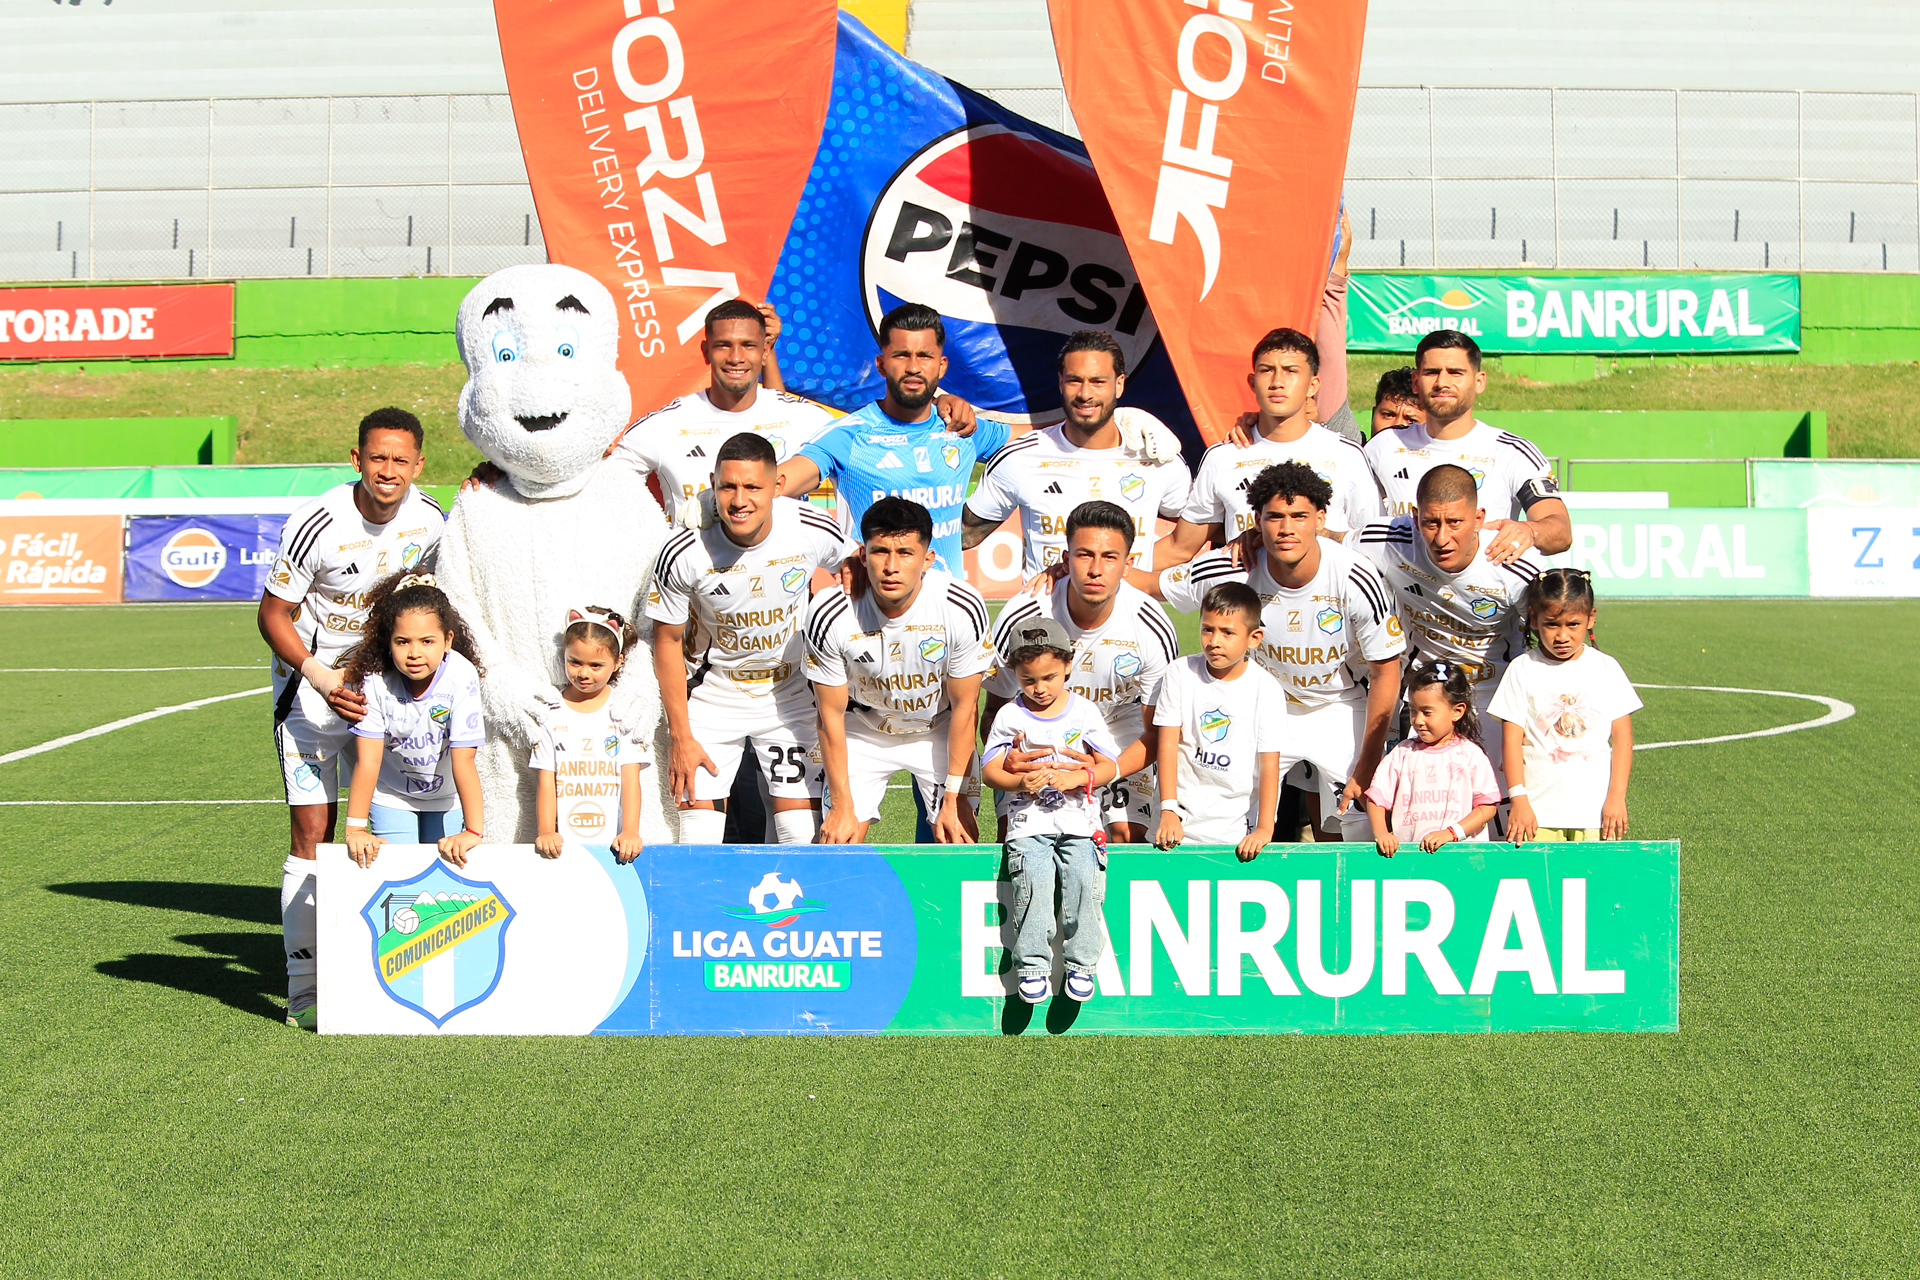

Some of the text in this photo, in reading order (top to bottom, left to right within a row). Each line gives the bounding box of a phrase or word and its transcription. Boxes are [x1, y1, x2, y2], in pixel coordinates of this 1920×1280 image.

[1161, 0, 1254, 178] FO
[573, 67, 665, 358] DELIVERY EXPRESS
[884, 200, 1148, 337] PEPSI
[1506, 288, 1764, 339] BANRURAL
[1388, 316, 1483, 336] BANRURAL
[1046, 460, 1081, 468] FORZA
[401, 526, 428, 538] FORZA
[10, 532, 84, 561] Fácil,
[341, 539, 373, 551] FORZA
[1852, 526, 1884, 568] Z
[167, 550, 222, 567] Gulf
[773, 553, 807, 566] FORZA
[5, 559, 107, 589] Rápida
[711, 564, 747, 574] FORZA
[749, 577, 763, 592] Z
[713, 604, 799, 628] BANRURAL
[1288, 611, 1300, 625] Z
[910, 624, 946, 632] FORZA
[1082, 652, 1093, 665] Z
[1257, 643, 1348, 666] ANRURAL
[1070, 682, 1134, 703] RURAL
[583, 738, 593, 751] Z
[768, 745, 806, 784] 25
[1195, 747, 1231, 767] HIJO
[1210, 763, 1229, 773] CREMA
[1401, 789, 1460, 808] BANRURAL
[568, 814, 605, 826] Gulf
[386, 900, 497, 977] COMUNICACIONES
[672, 930, 883, 958] LIGA GUATE
[714, 964, 841, 988] BANRURAL
